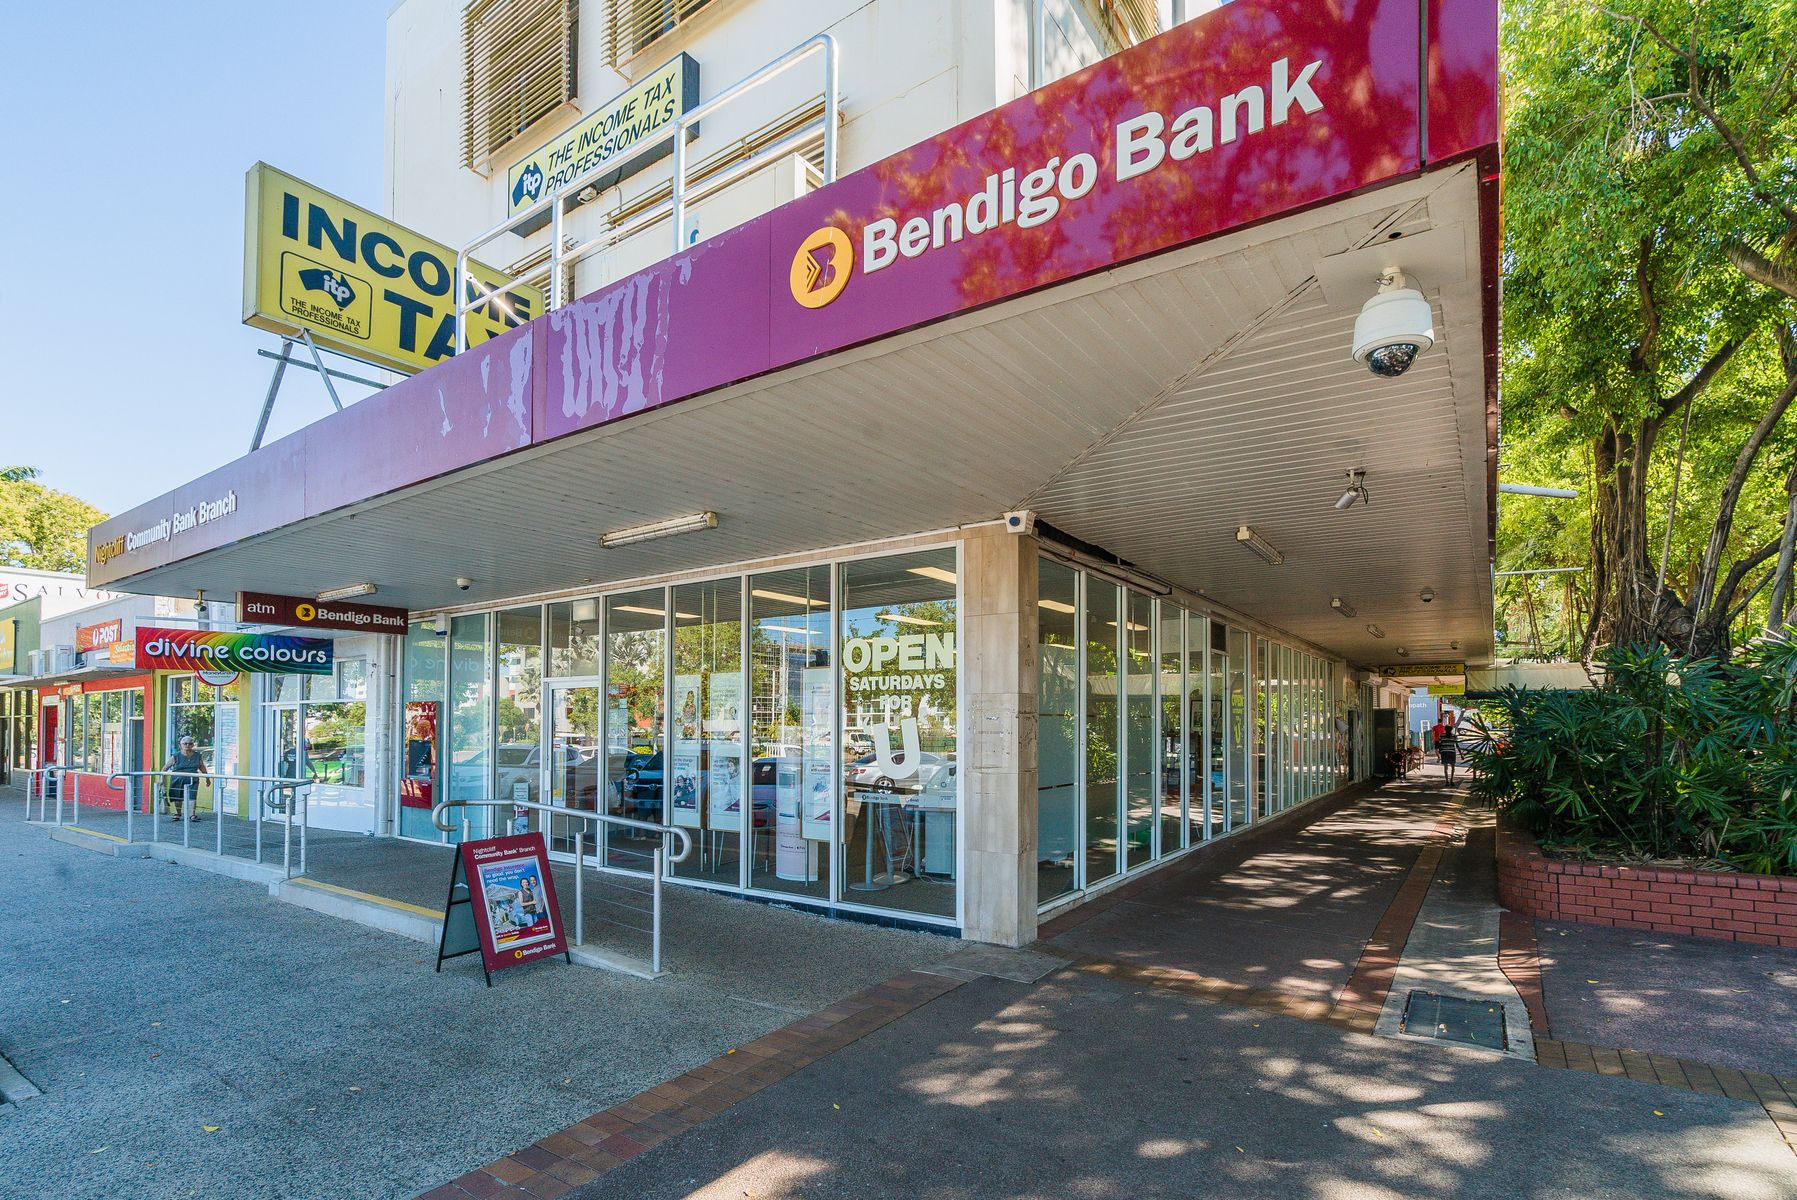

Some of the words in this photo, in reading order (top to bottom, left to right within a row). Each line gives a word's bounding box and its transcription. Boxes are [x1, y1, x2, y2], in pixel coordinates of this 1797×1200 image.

[549, 140, 576, 172] THE
[577, 97, 638, 152] INCOME
[644, 72, 676, 110] TAX
[545, 99, 675, 196] PROFESSIONALS
[863, 153, 1098, 274] Bendigo
[1116, 56, 1324, 182] Bank
[522, 173, 542, 195] itp
[282, 191, 531, 329] INCOME
[323, 274, 351, 302] itp
[290, 296, 307, 308] THE
[310, 304, 342, 322] INCOME
[346, 316, 361, 328] TAX
[291, 305, 360, 335] PROFESSIONALS
[384, 288, 499, 361] TA
[127, 518, 172, 551] Community
[173, 506, 198, 534] Bank
[199, 490, 237, 524] Branch
[247, 602, 275, 615] atm
[318, 608, 371, 626] Bendigo
[373, 613, 405, 627] Bank
[100, 624, 119, 644] POST
[145, 638, 229, 659] divine
[239, 645, 327, 664] colours
[843, 632, 954, 673] OPEN
[849, 674, 945, 691] SATURDAYS
[879, 694, 912, 711] FOR
[873, 717, 921, 779] U
[473, 846, 496, 855] Nightcliff
[474, 850, 503, 860] Community
[522, 946, 543, 956] Bendigo
[543, 943, 556, 951] Bank
